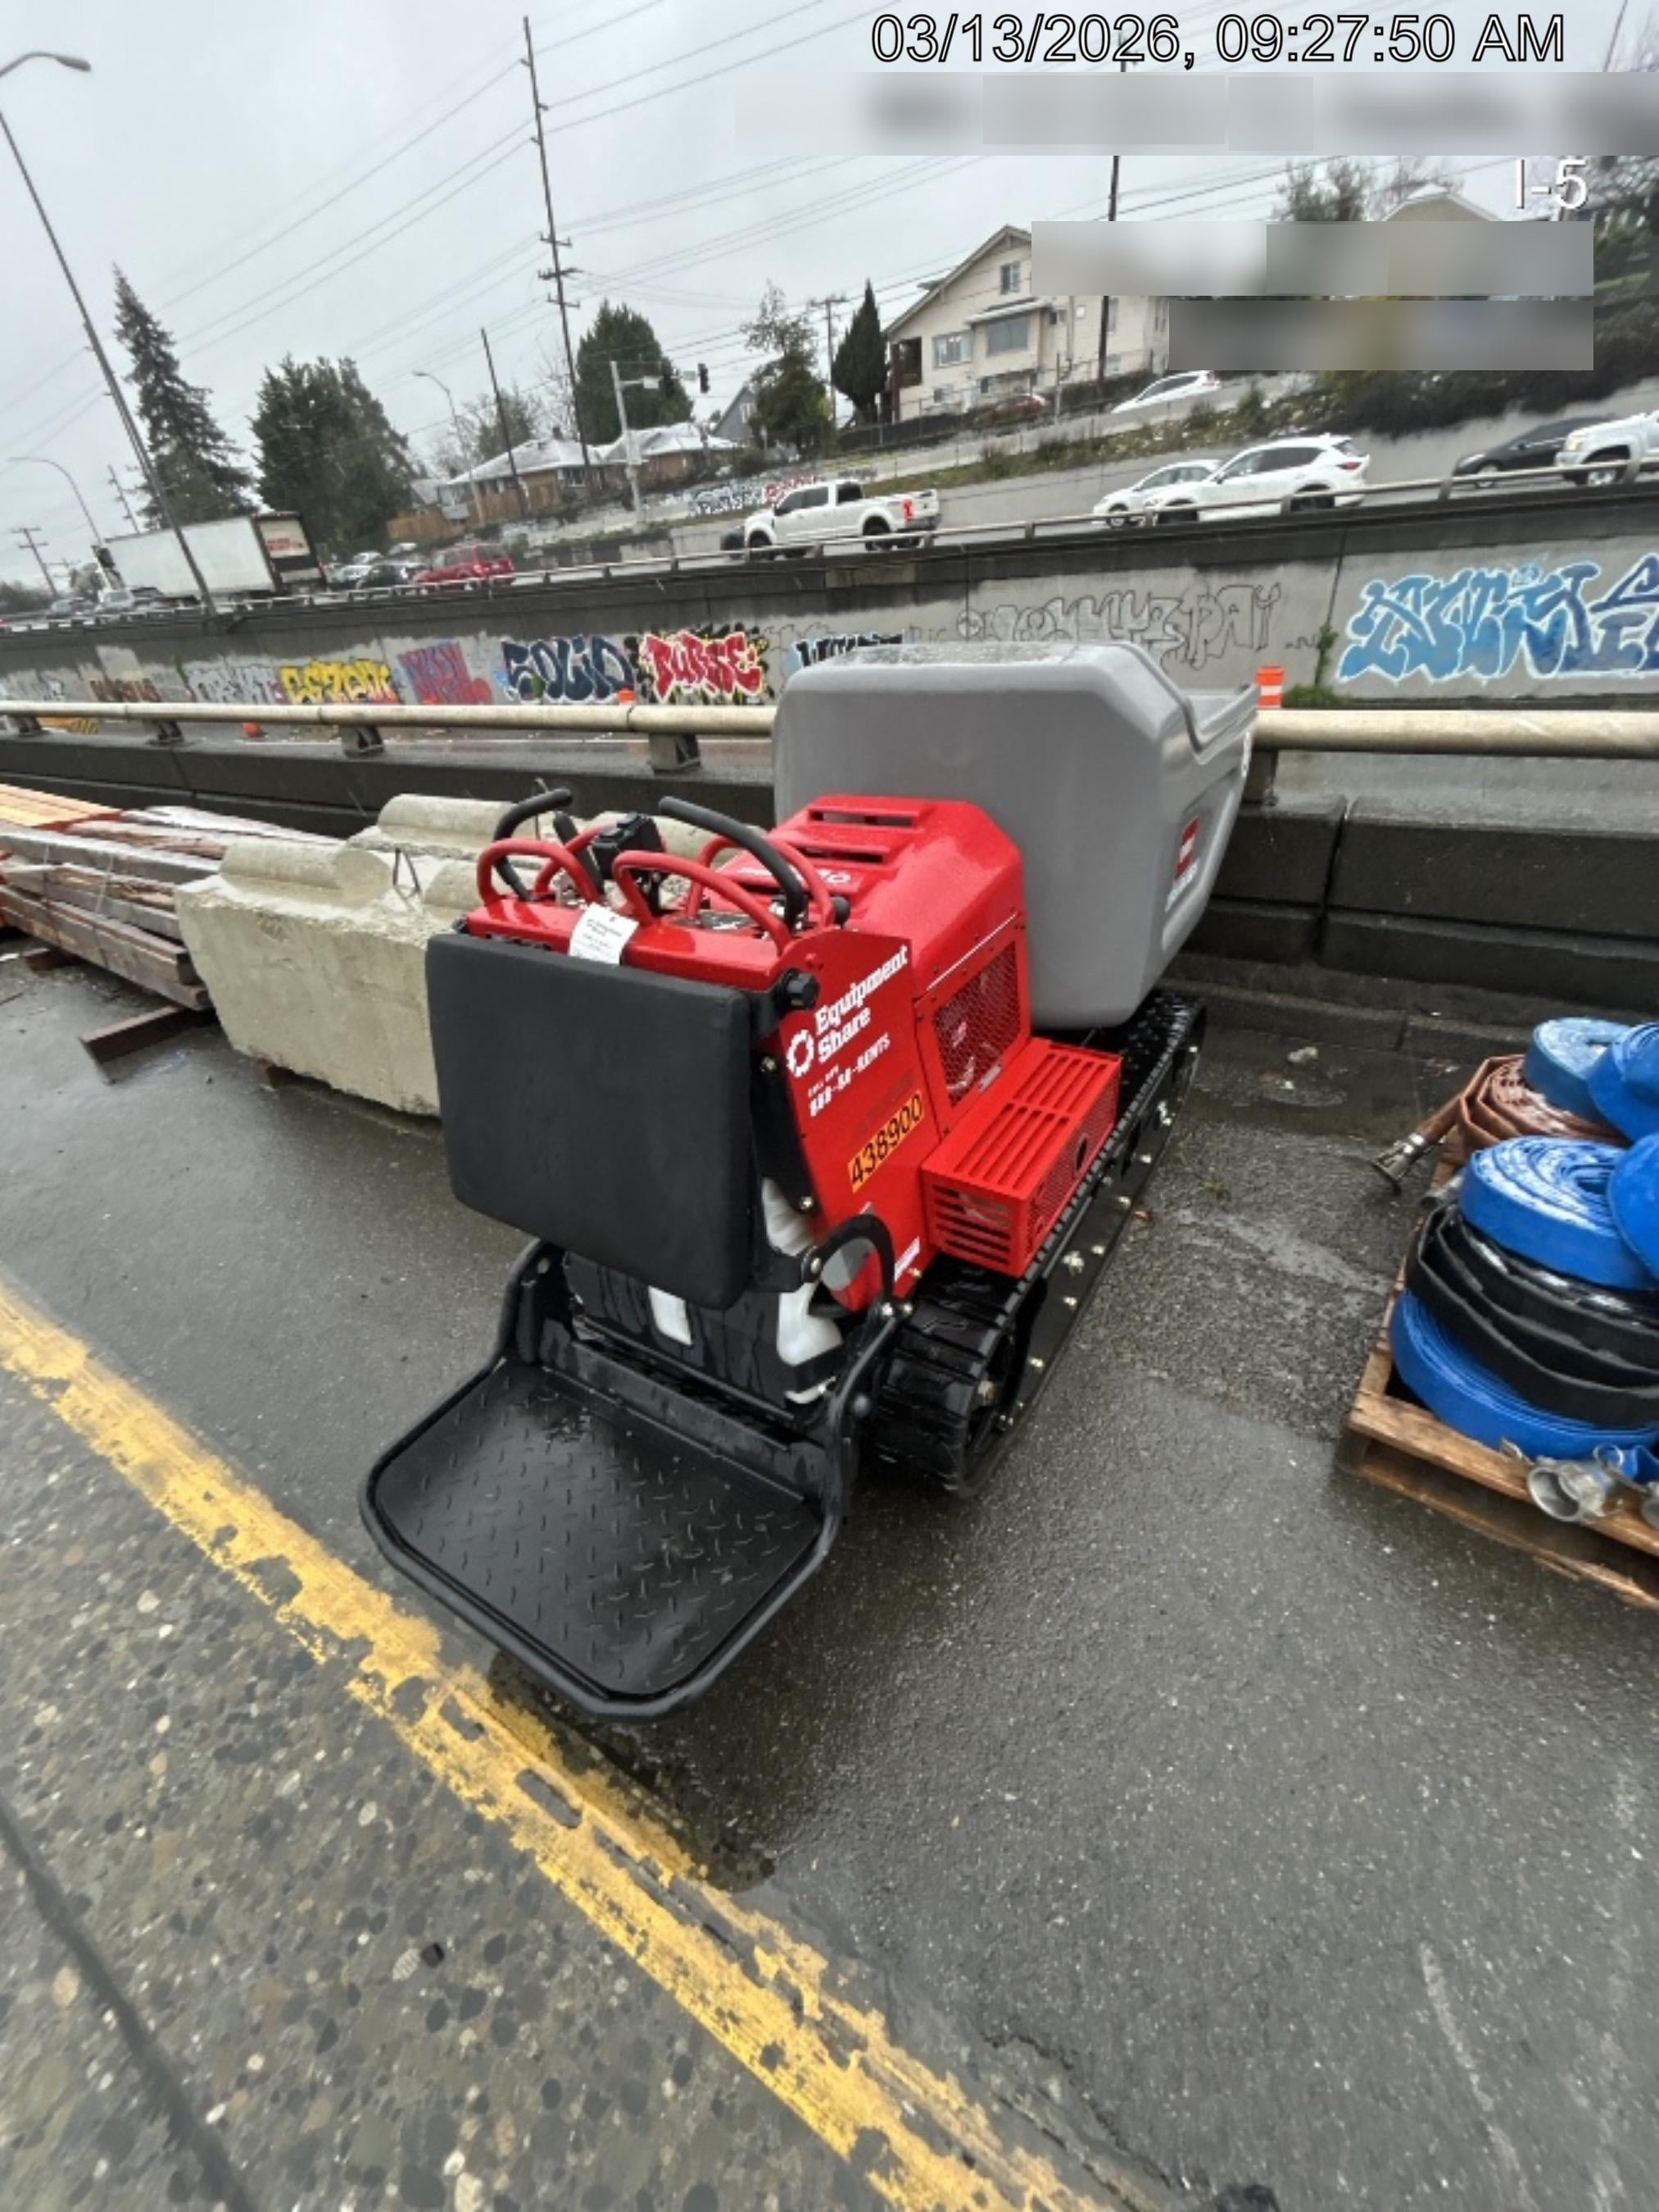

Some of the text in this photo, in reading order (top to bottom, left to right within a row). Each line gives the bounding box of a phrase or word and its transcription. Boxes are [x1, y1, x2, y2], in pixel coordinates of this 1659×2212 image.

[815, 945, 908, 1036] Equipment
[818, 1007, 871, 1063] Share
[852, 1094, 922, 1183] 438900
